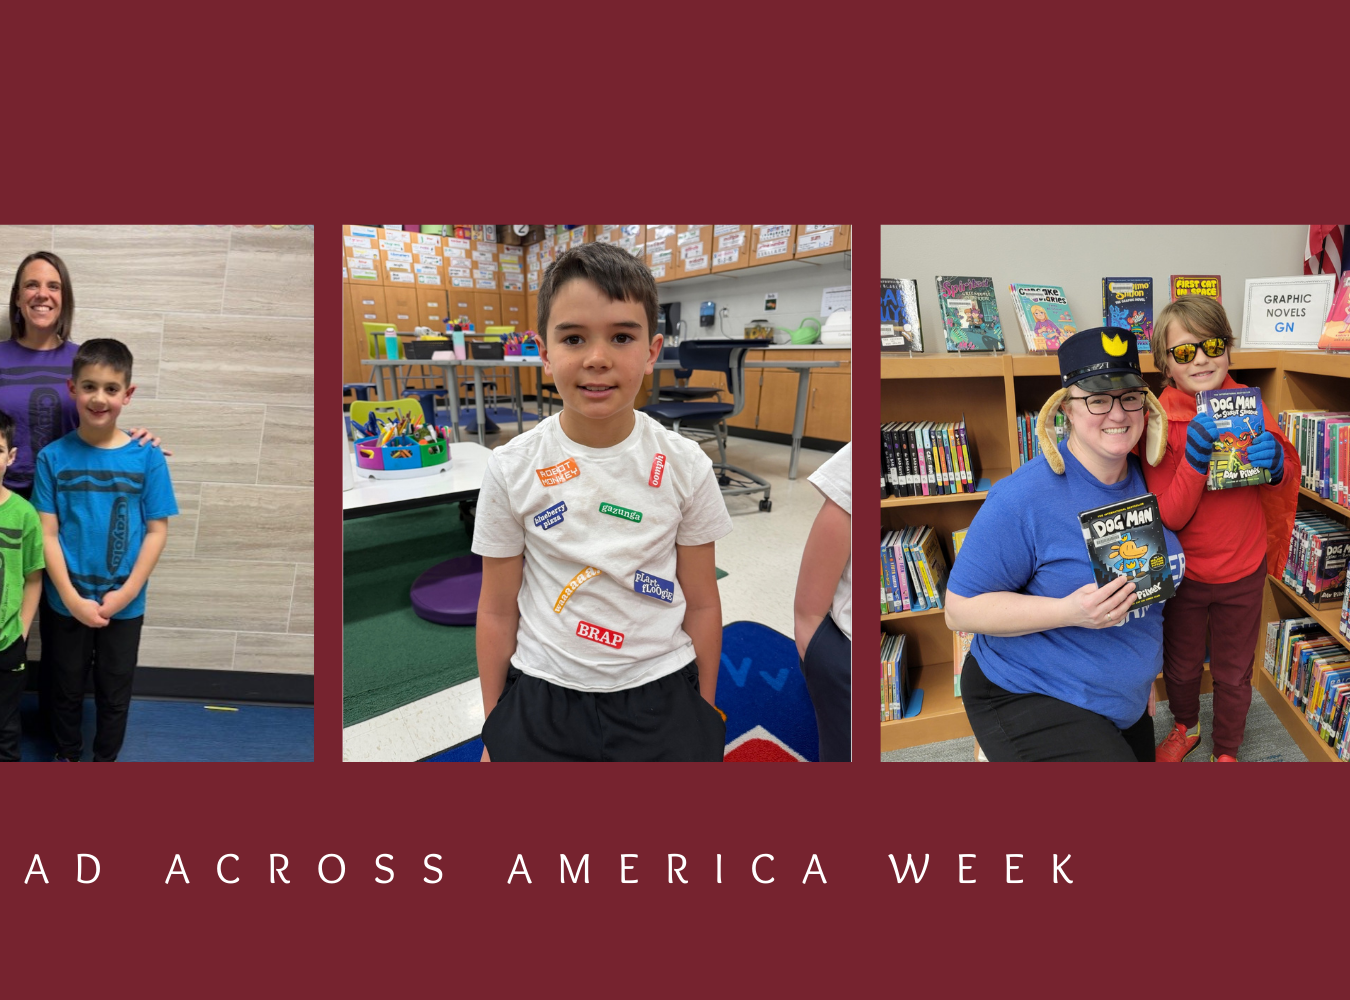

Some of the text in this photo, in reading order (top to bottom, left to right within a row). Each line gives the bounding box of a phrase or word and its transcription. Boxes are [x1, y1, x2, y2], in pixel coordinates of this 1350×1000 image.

[518, 224, 526, 233] 2
[942, 279, 989, 297] Spirited
[1176, 280, 1217, 288] FIRST CAT
[1191, 288, 1216, 296] SPACE
[1264, 294, 1312, 304] GRAPHIC
[1266, 308, 1306, 317] NOVELS
[1275, 322, 1295, 332] GN
[1210, 396, 1256, 412] DOG MAN
[540, 462, 570, 478] ROBOT
[541, 468, 578, 485] MONKEY
[652, 455, 663, 486] oomph
[534, 504, 566, 525] blueberry
[601, 504, 640, 520] gazunga
[543, 515, 562, 529] pizza
[1092, 507, 1153, 537] DOG MAN
[112, 502, 127, 566] Crayola
[1327, 546, 1342, 556] DOG
[578, 623, 623, 646] BRAP
